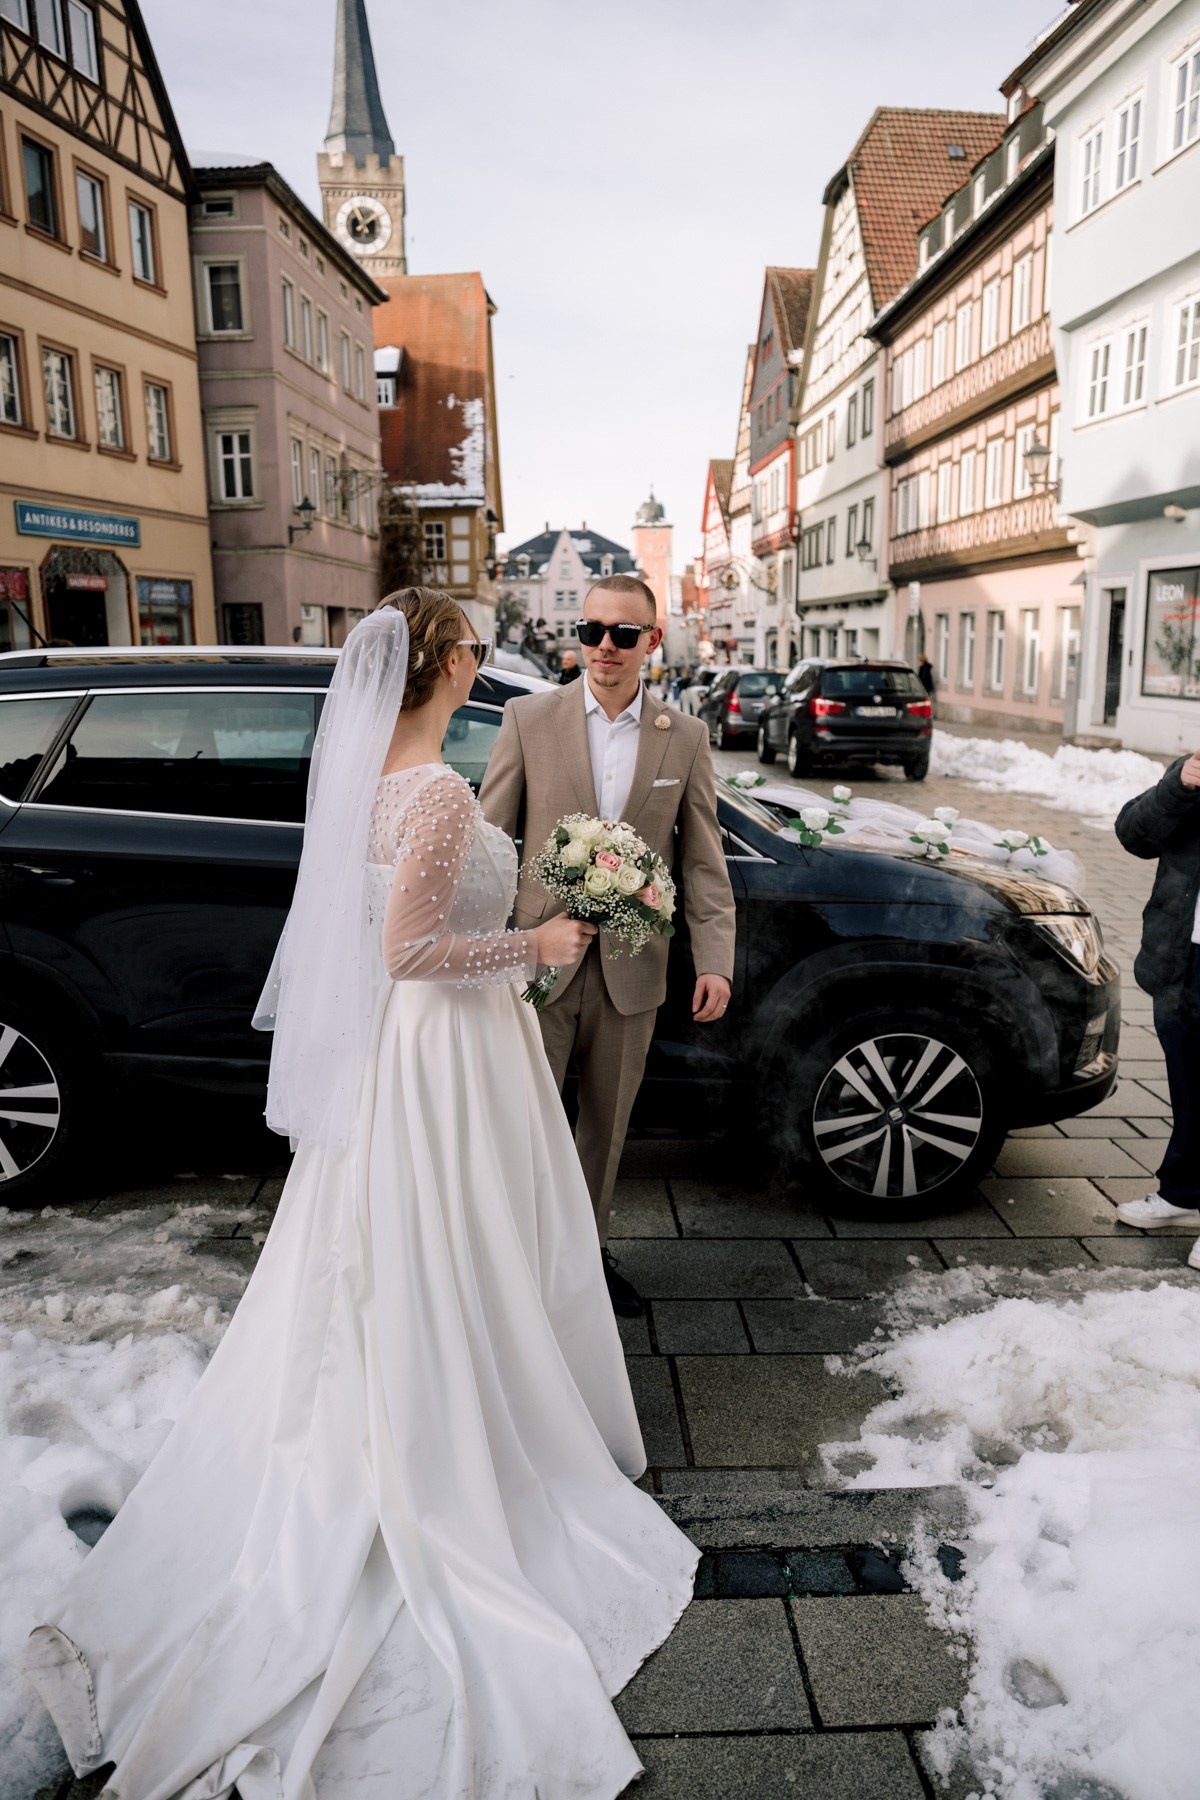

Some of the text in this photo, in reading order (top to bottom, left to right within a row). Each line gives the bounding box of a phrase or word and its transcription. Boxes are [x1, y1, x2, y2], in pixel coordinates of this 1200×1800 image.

[24, 511, 68, 529] ANTIKES
[77, 519, 136, 538] BESONDERES
[1156, 584, 1185, 602] LEON
